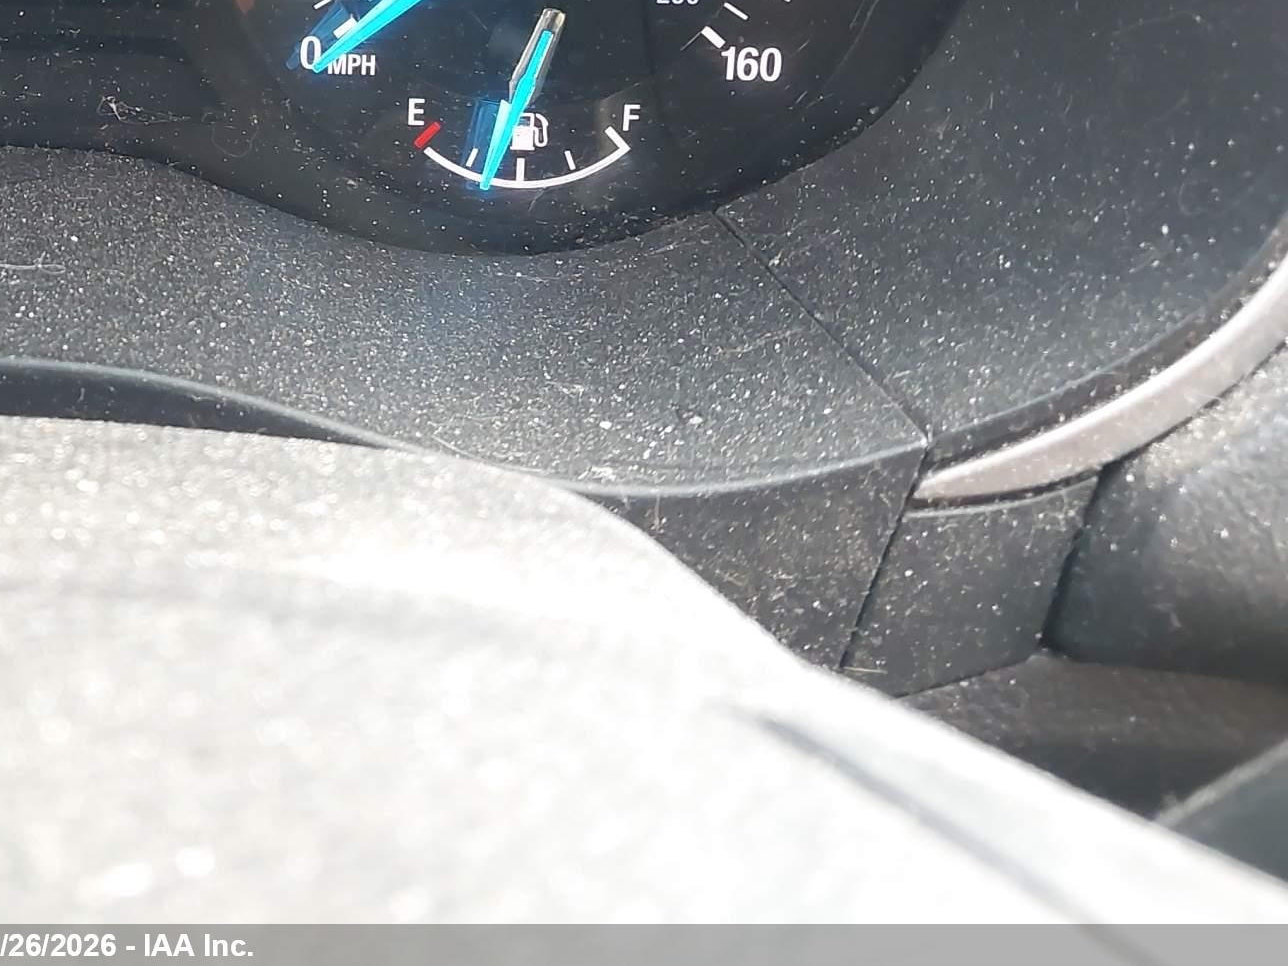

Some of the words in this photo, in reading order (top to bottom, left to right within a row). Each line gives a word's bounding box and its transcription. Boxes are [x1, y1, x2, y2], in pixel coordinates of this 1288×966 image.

[300, 35, 322, 70] 0
[327, 54, 377, 76] MPH
[721, 45, 783, 83] 160
[407, 98, 425, 126] E
[623, 105, 640, 131] F
